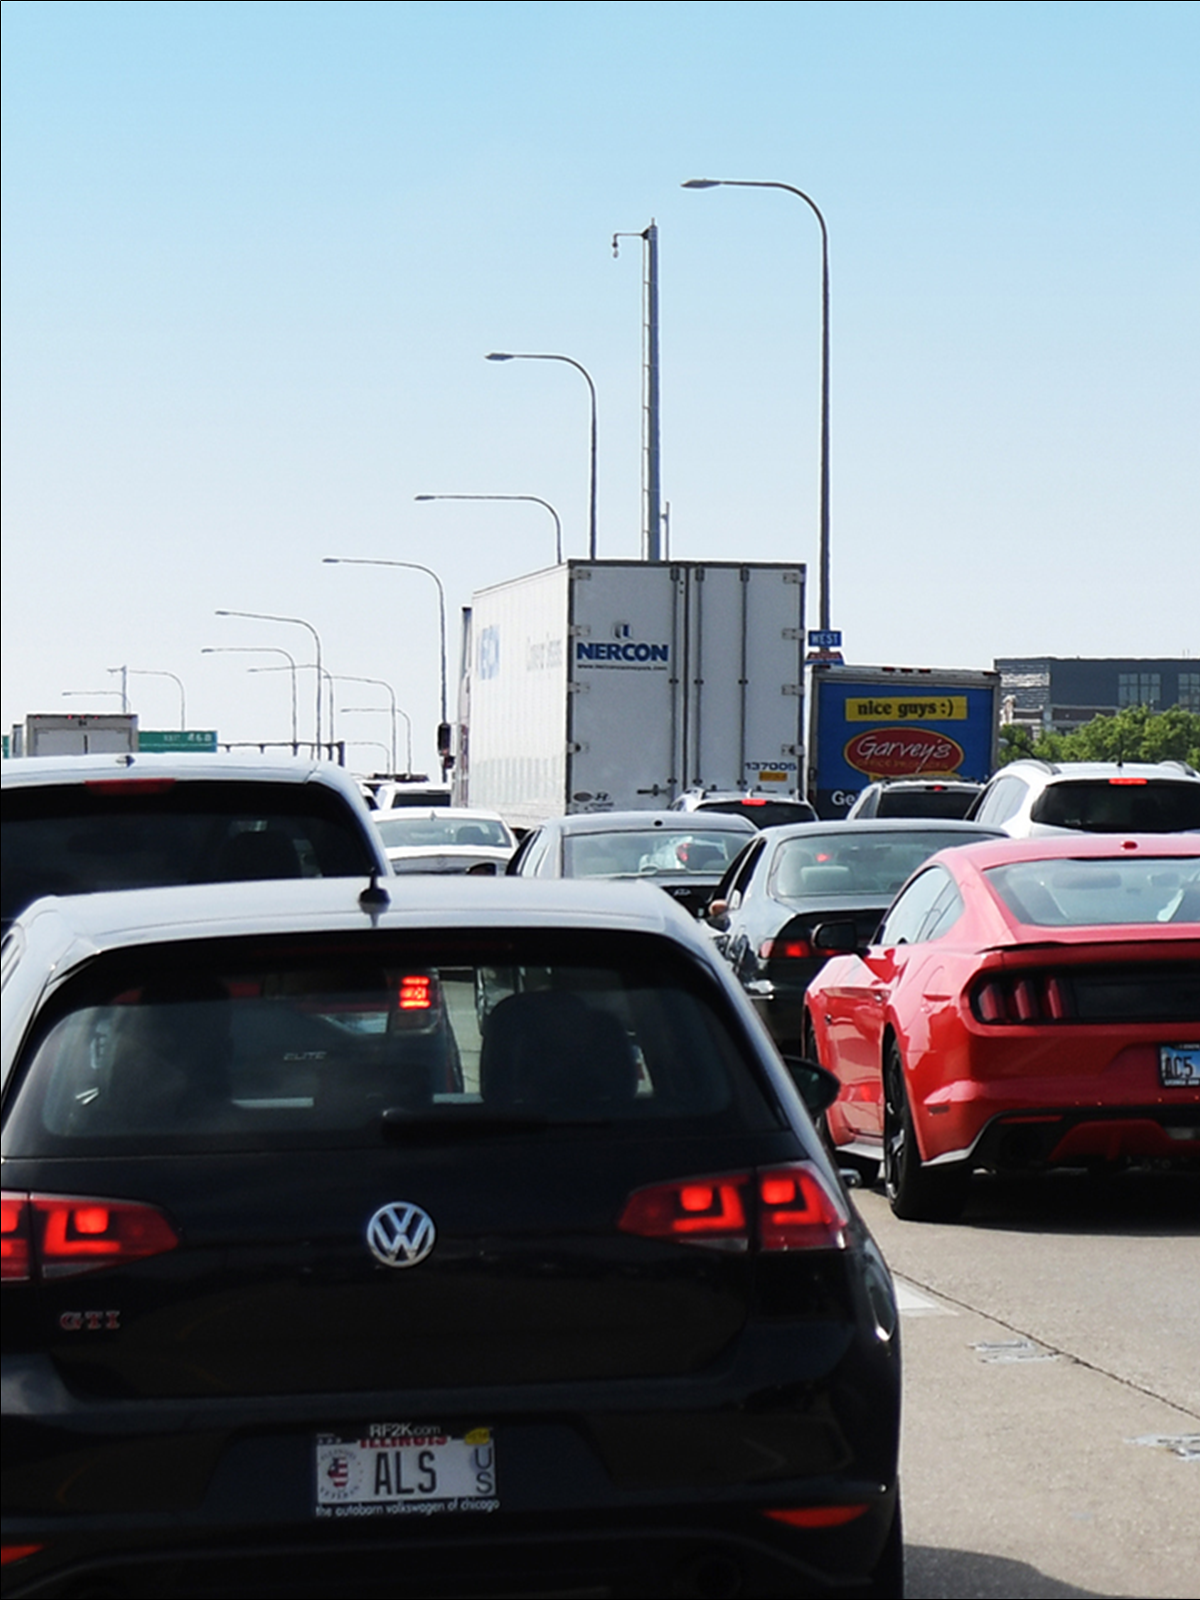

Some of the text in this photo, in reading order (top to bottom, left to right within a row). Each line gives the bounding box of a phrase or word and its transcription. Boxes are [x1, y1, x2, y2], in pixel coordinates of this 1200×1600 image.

[577, 642, 669, 662] NERCON
[857, 700, 892, 716] nice
[898, 702, 937, 718] guys
[856, 735, 953, 774] Garvey's
[831, 790, 858, 806] Ge
[60, 1310, 120, 1331] GTI
[369, 1423, 441, 1438] RF2K.com
[374, 1451, 437, 1496] ALS
[315, 1504, 332, 1517] the
[386, 1500, 445, 1516] volkswagen
[447, 1498, 459, 1510] of
[460, 1498, 501, 1513] chicago
